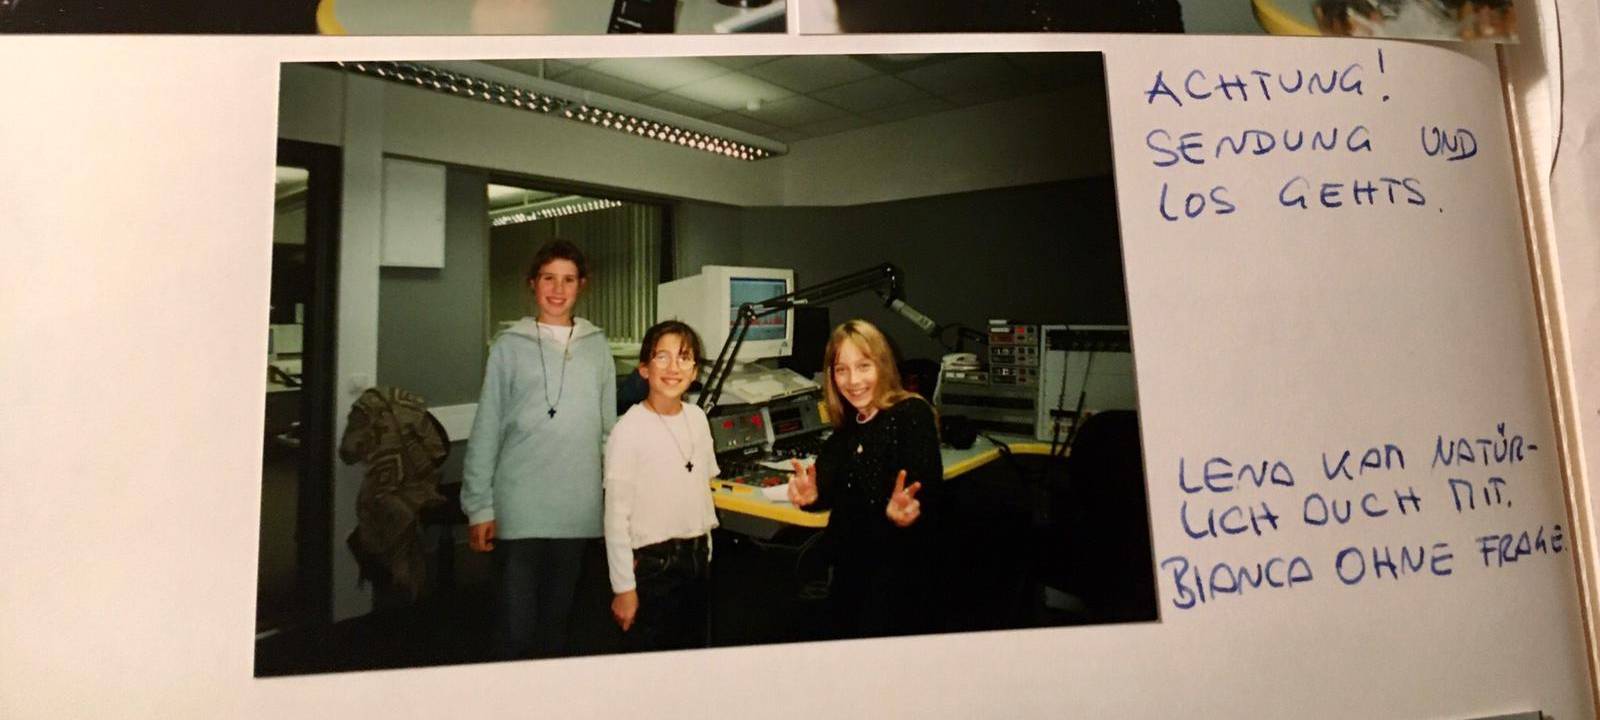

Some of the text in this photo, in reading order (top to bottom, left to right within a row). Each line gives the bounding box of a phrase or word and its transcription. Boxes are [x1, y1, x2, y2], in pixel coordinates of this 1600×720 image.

[1145, 48, 1389, 107] ACHTUNG!
[1146, 125, 1477, 167] SENDUNG UND
[1159, 176, 1443, 221] LOS GEHTS.
[1179, 423, 1538, 493] LENA KAM NATÜR-
[1181, 478, 1512, 539] LICH AUCH MIT.
[1161, 556, 1313, 609] BIANCA
[1335, 543, 1453, 585] OHNE
